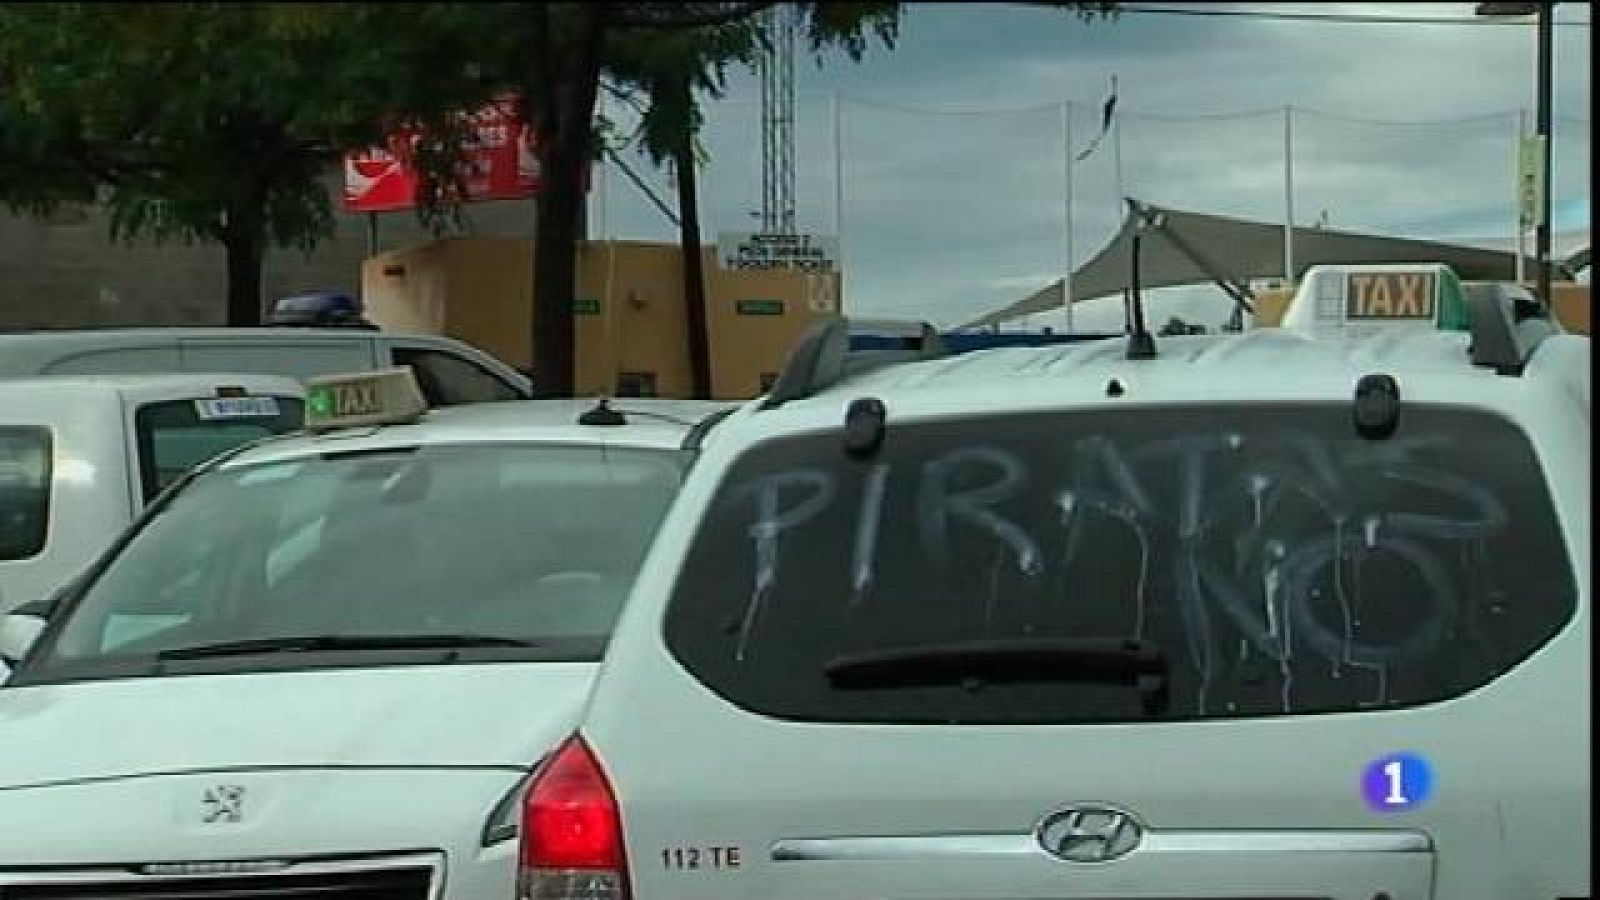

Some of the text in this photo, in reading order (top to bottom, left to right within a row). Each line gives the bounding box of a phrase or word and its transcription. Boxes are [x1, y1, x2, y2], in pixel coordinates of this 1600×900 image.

[1349, 274, 1432, 316] TAXI
[333, 382, 386, 416] TAXI
[725, 430, 1508, 597] PIRATAS
[660, 846, 740, 870] 112 TE
